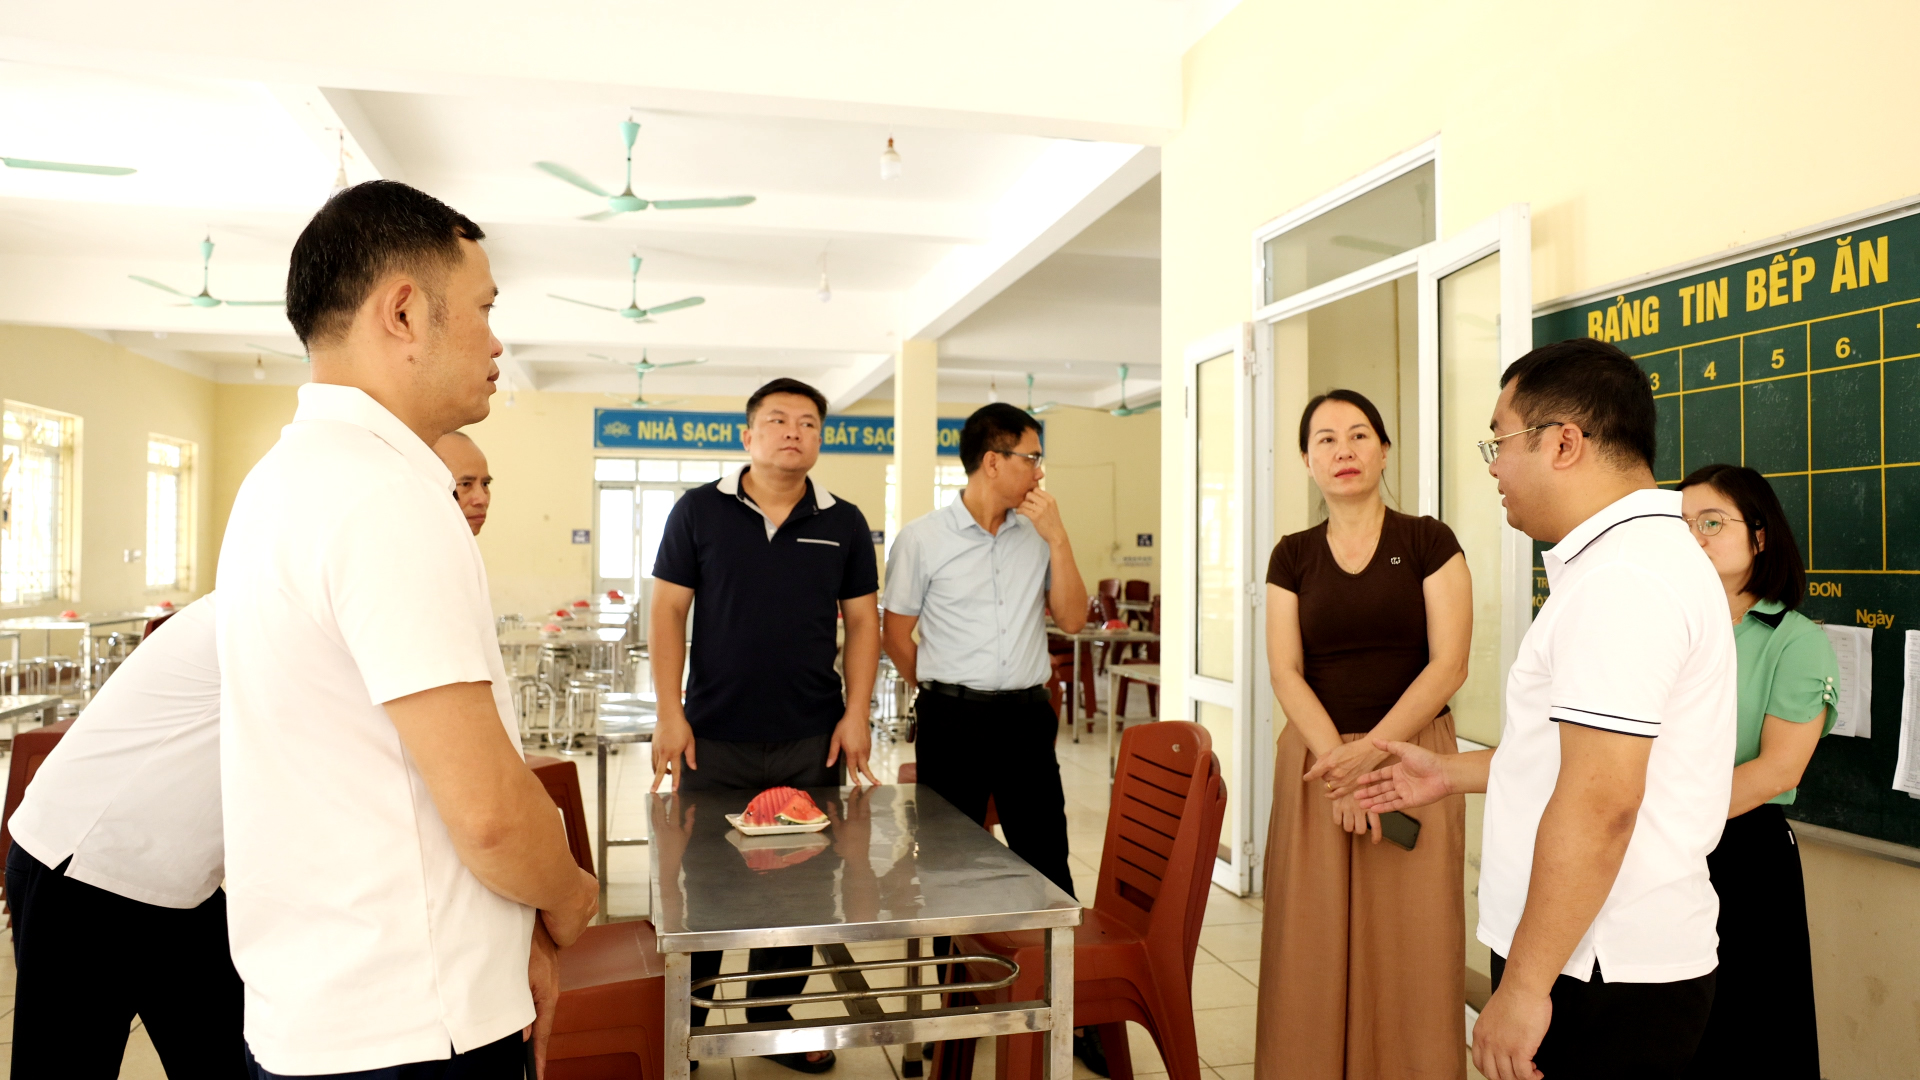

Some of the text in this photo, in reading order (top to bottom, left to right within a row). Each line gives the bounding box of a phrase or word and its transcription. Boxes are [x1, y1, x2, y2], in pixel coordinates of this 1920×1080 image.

[1587, 236, 1889, 343] BẢNG TIN BẾP ĂN
[1650, 337, 1850, 391] 3 4 5 6
[637, 416, 678, 442] NHÀ
[682, 422, 733, 448] SẠCH
[824, 421, 859, 446] BÁT
[1808, 581, 1842, 598] ĐƠN
[1856, 609, 1895, 629] Ngày
